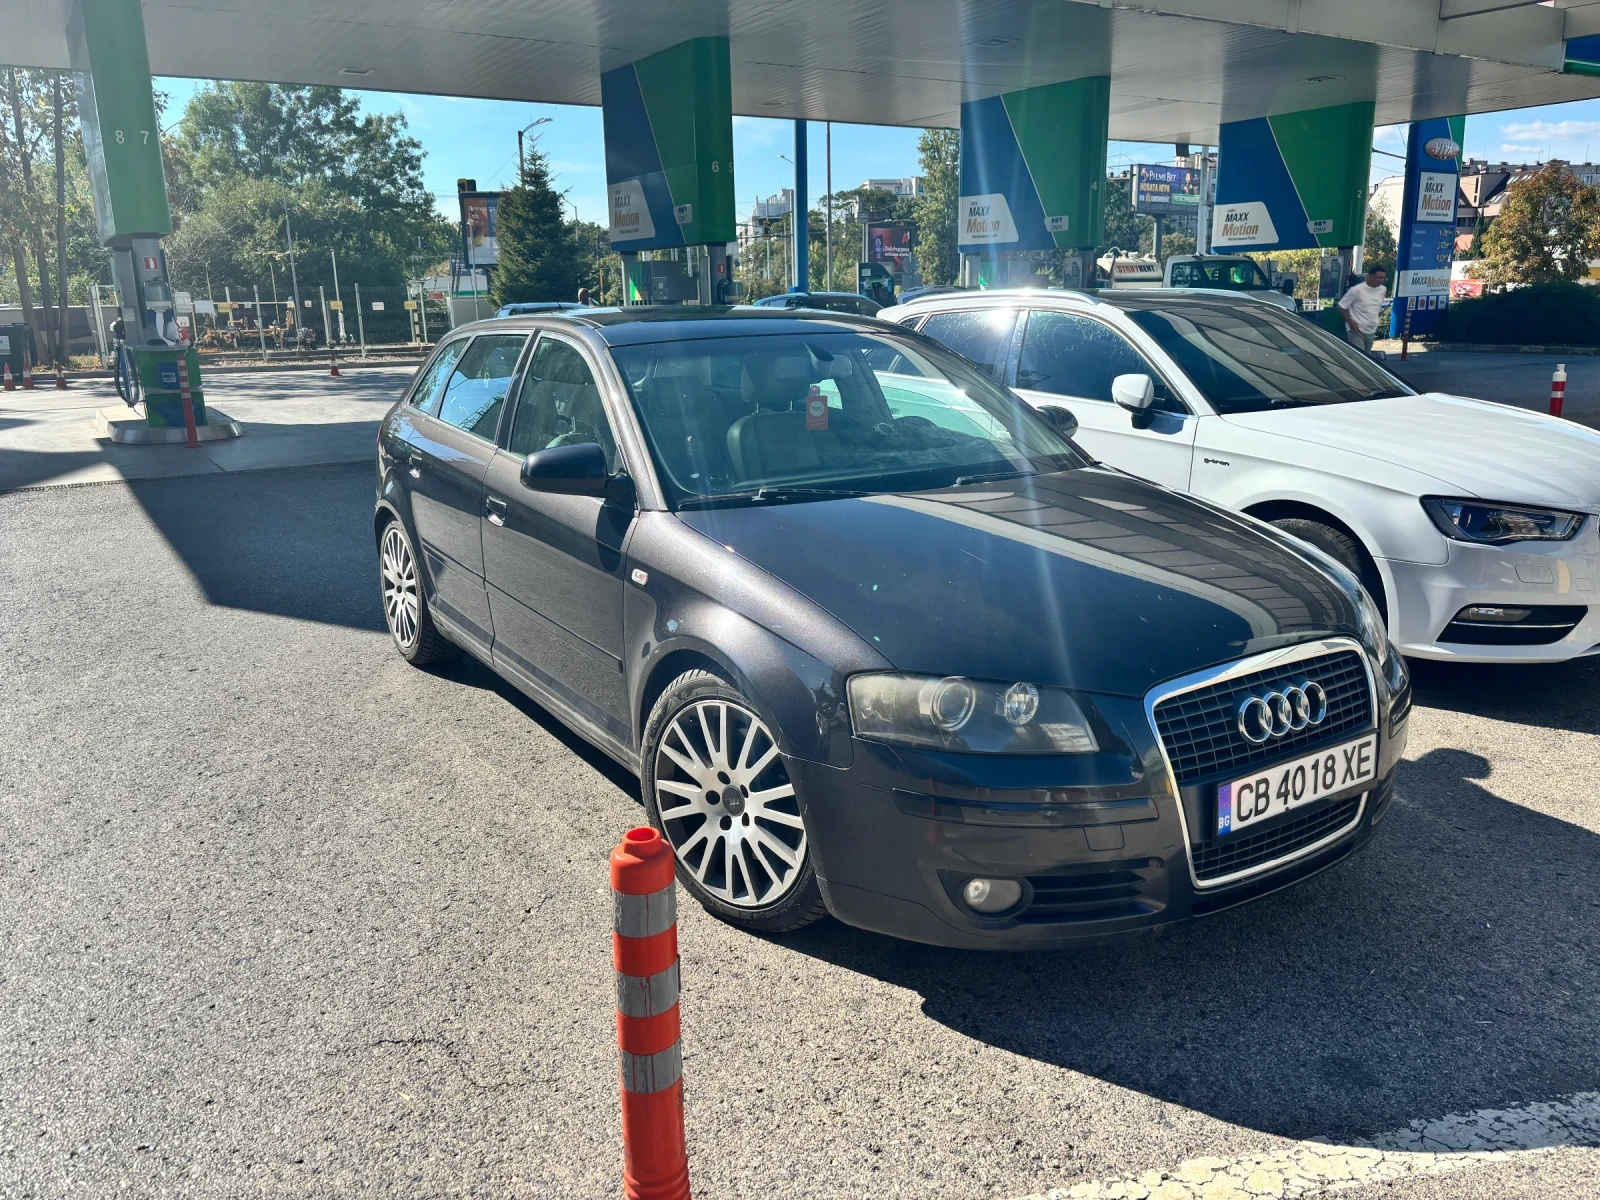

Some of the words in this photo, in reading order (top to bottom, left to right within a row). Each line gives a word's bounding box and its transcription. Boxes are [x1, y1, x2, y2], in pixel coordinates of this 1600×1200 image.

[115, 130, 125, 144] 8
[140, 130, 149, 145] 7
[711, 161, 719, 173] 6
[1091, 181, 1097, 190] 4
[1425, 182, 1444, 194] MAXX
[1356, 189, 1362, 198] 2
[614, 195, 631, 209] MAXX
[1421, 193, 1452, 211] Motion
[969, 205, 990, 217] MAXX
[1225, 212, 1250, 222] MAXX
[614, 208, 640, 228] Motion
[966, 217, 1000, 233] Motion
[1222, 222, 1259, 236] Motion
[901, 231, 910, 244] A1
[1116, 265, 1155, 273] STROYRENT
[1411, 276, 1428, 286] MAXX
[1427, 276, 1450, 288] Motion
[1236, 777, 1270, 822] CB
[1276, 753, 1336, 806] 4018
[1341, 741, 1372, 785] XE
[1218, 815, 1230, 829] BG
